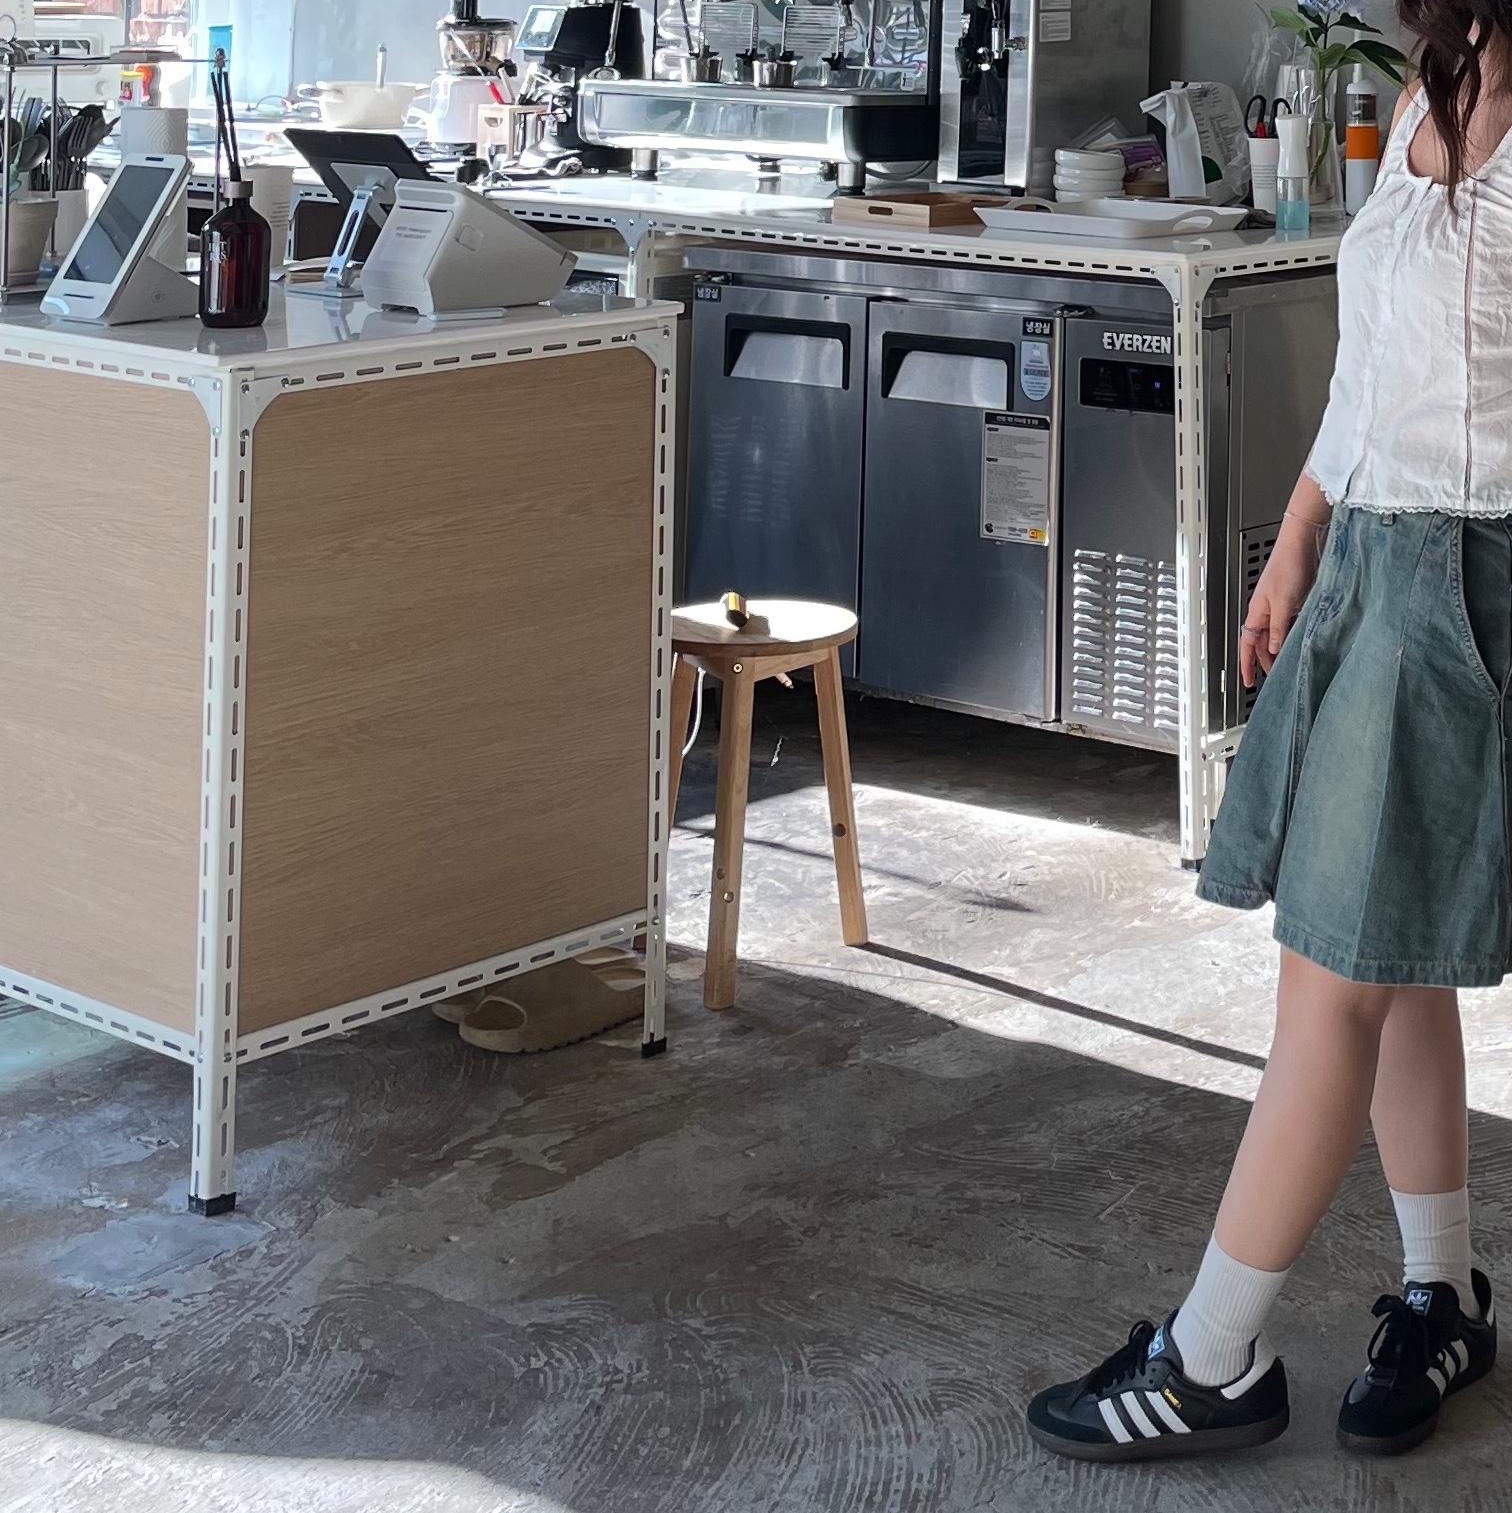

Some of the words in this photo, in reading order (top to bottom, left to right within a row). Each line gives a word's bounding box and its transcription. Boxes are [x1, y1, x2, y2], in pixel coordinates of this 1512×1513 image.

[697, 287, 719, 299] 냉장실
[1025, 320, 1051, 334] 냉장실
[1102, 331, 1172, 355] EVERZEN
